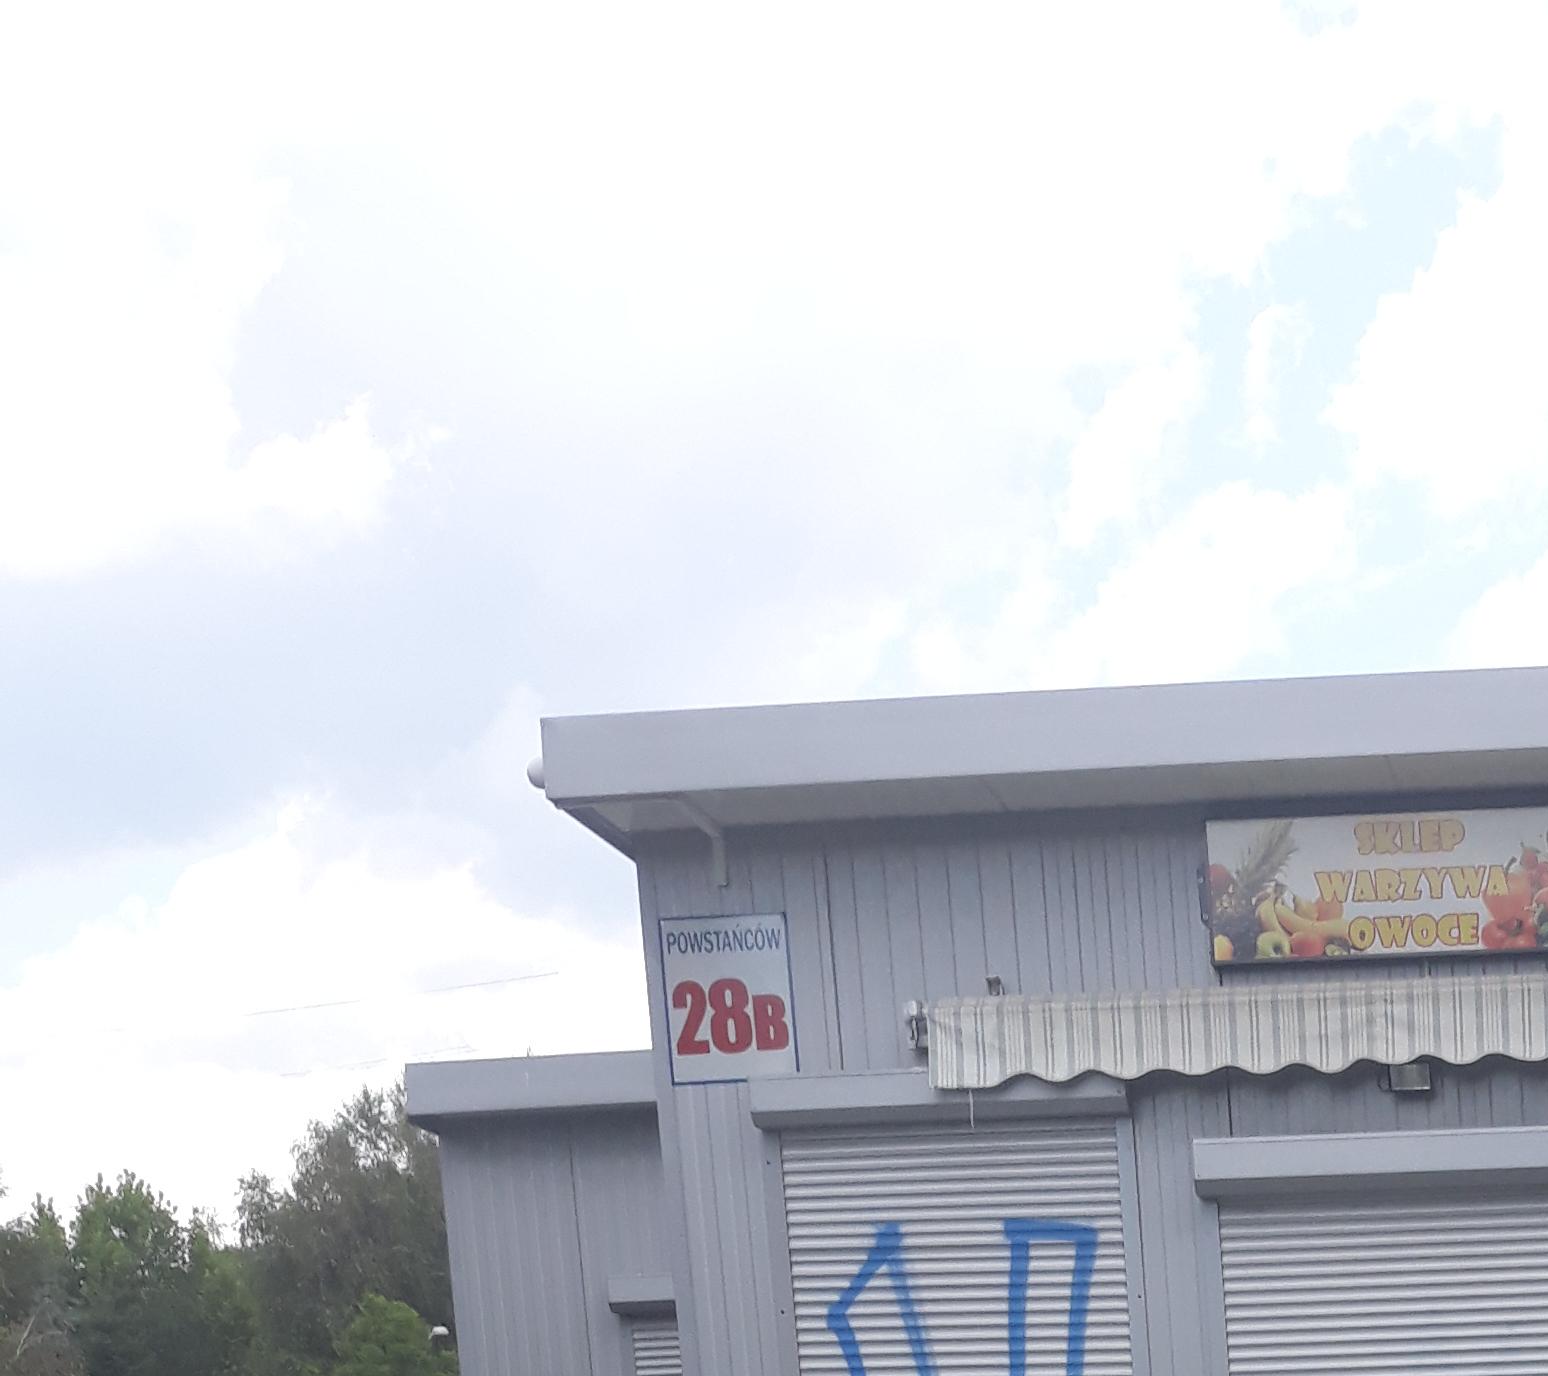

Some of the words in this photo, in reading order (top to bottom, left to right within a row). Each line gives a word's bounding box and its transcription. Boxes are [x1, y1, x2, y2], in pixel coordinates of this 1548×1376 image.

[1354, 818, 1466, 856] SKLEP
[1314, 865, 1509, 904] WARZYWA
[666, 923, 781, 954] POWSTAŃCÓW
[1348, 913, 1480, 952] OWOCE
[672, 978, 790, 1056] 28B
